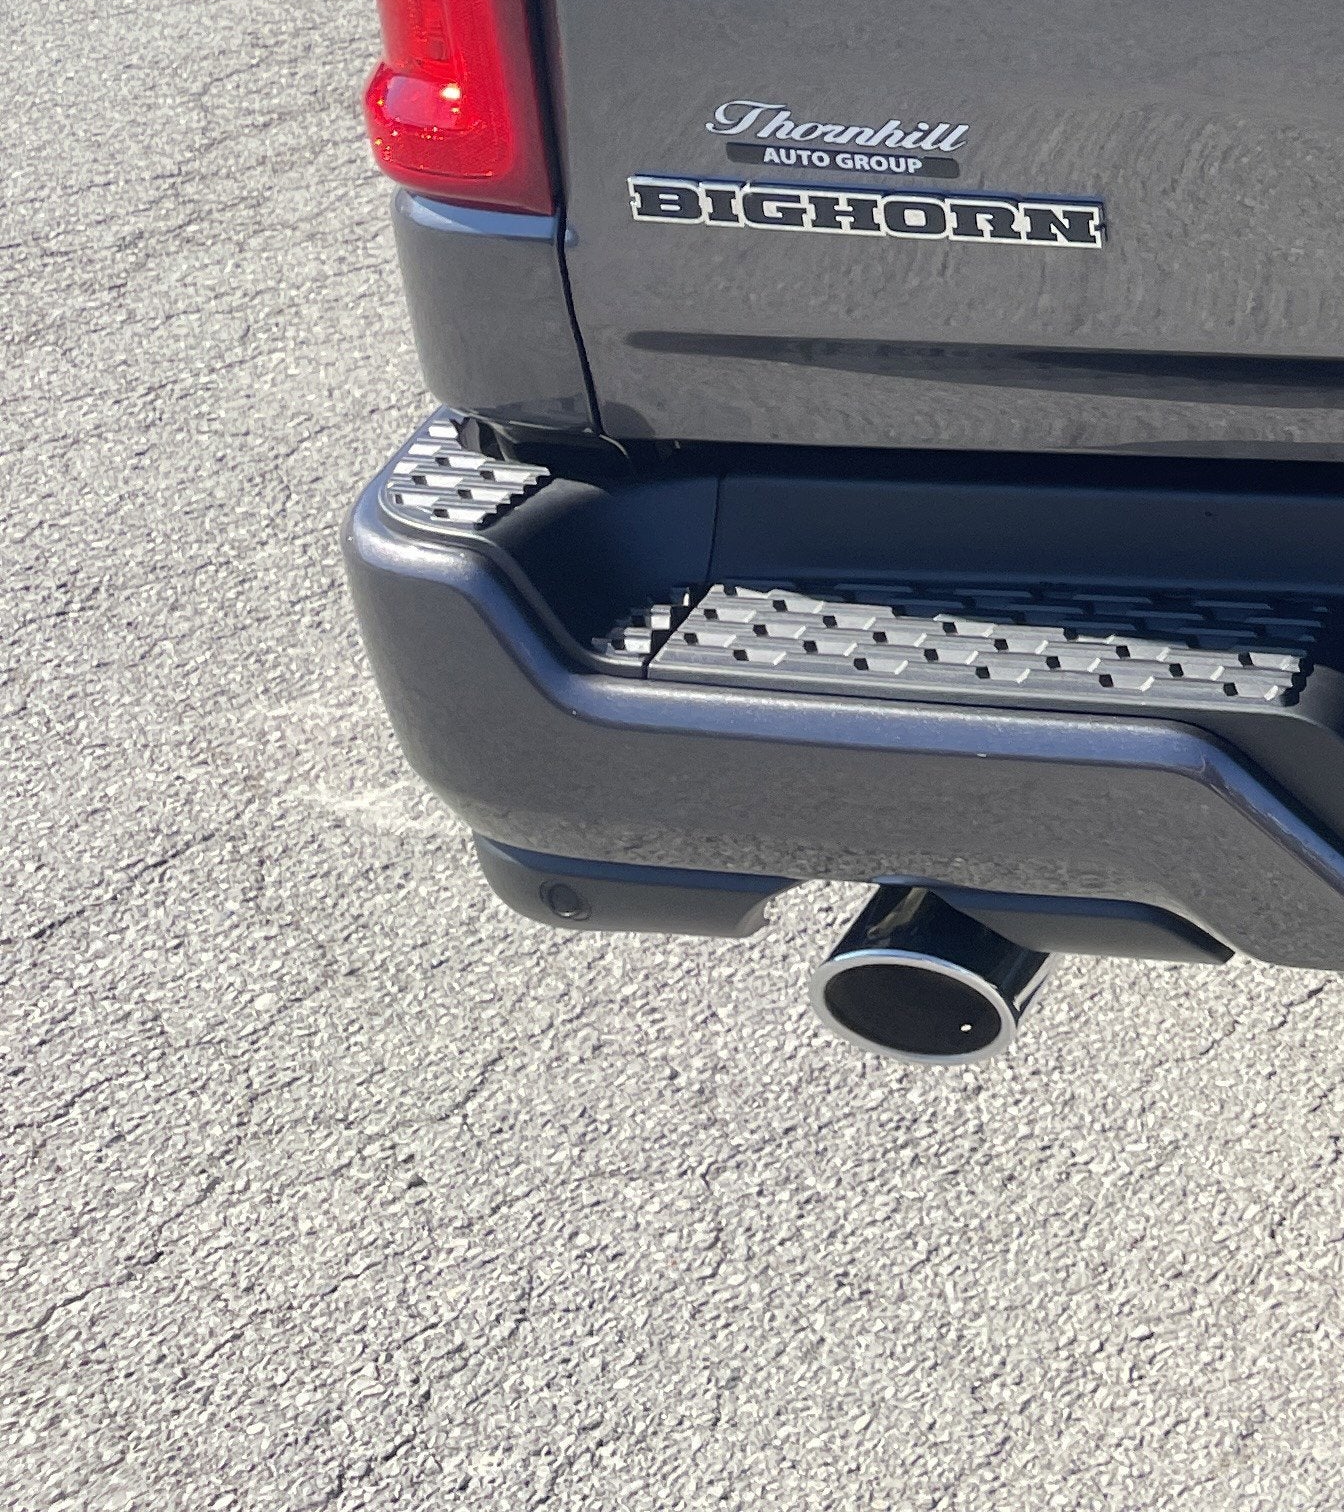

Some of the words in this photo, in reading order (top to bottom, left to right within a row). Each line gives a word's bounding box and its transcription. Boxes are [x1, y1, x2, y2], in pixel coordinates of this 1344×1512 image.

[705, 100, 970, 152] Thornhill
[763, 146, 830, 168] AUTO
[835, 152, 923, 174] GROUP
[627, 175, 1103, 248] BIGHORN
